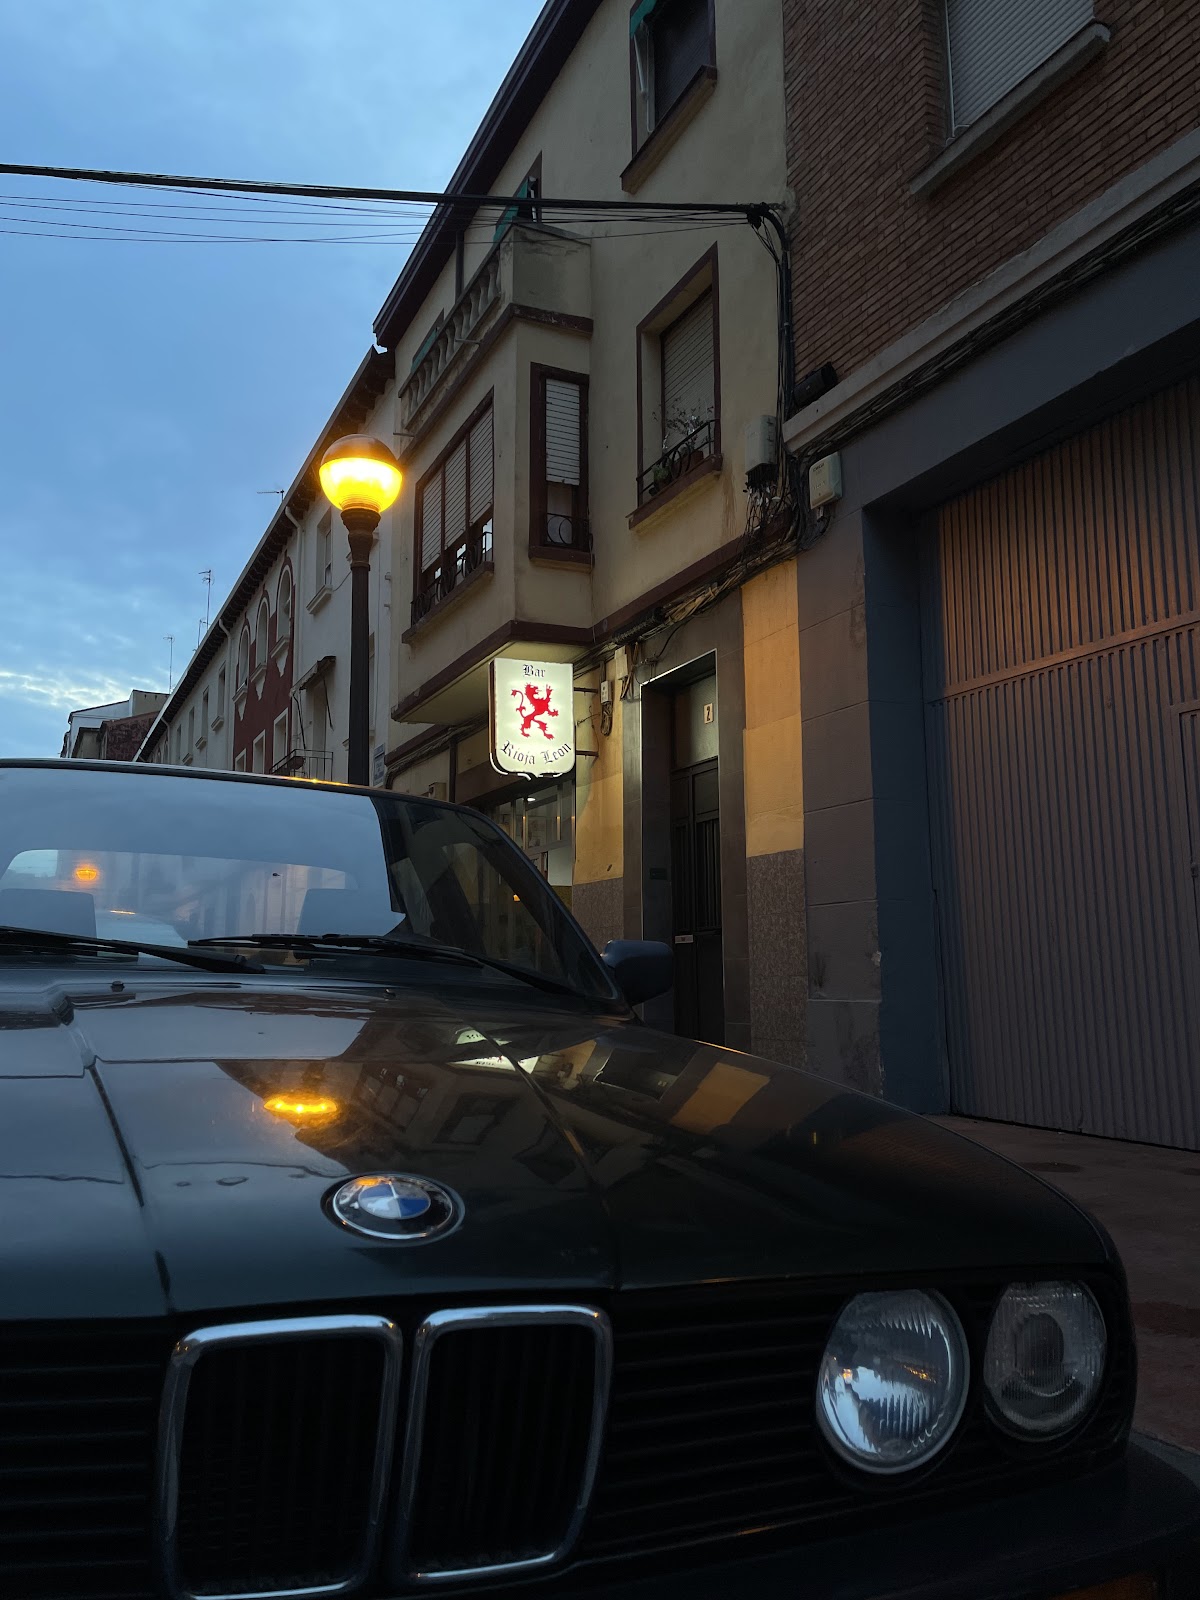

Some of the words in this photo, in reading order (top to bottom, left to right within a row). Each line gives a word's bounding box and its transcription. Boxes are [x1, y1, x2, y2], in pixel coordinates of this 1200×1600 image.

[523, 664, 546, 677] Bar
[501, 740, 535, 765] Rioja
[541, 743, 572, 764] Leon
